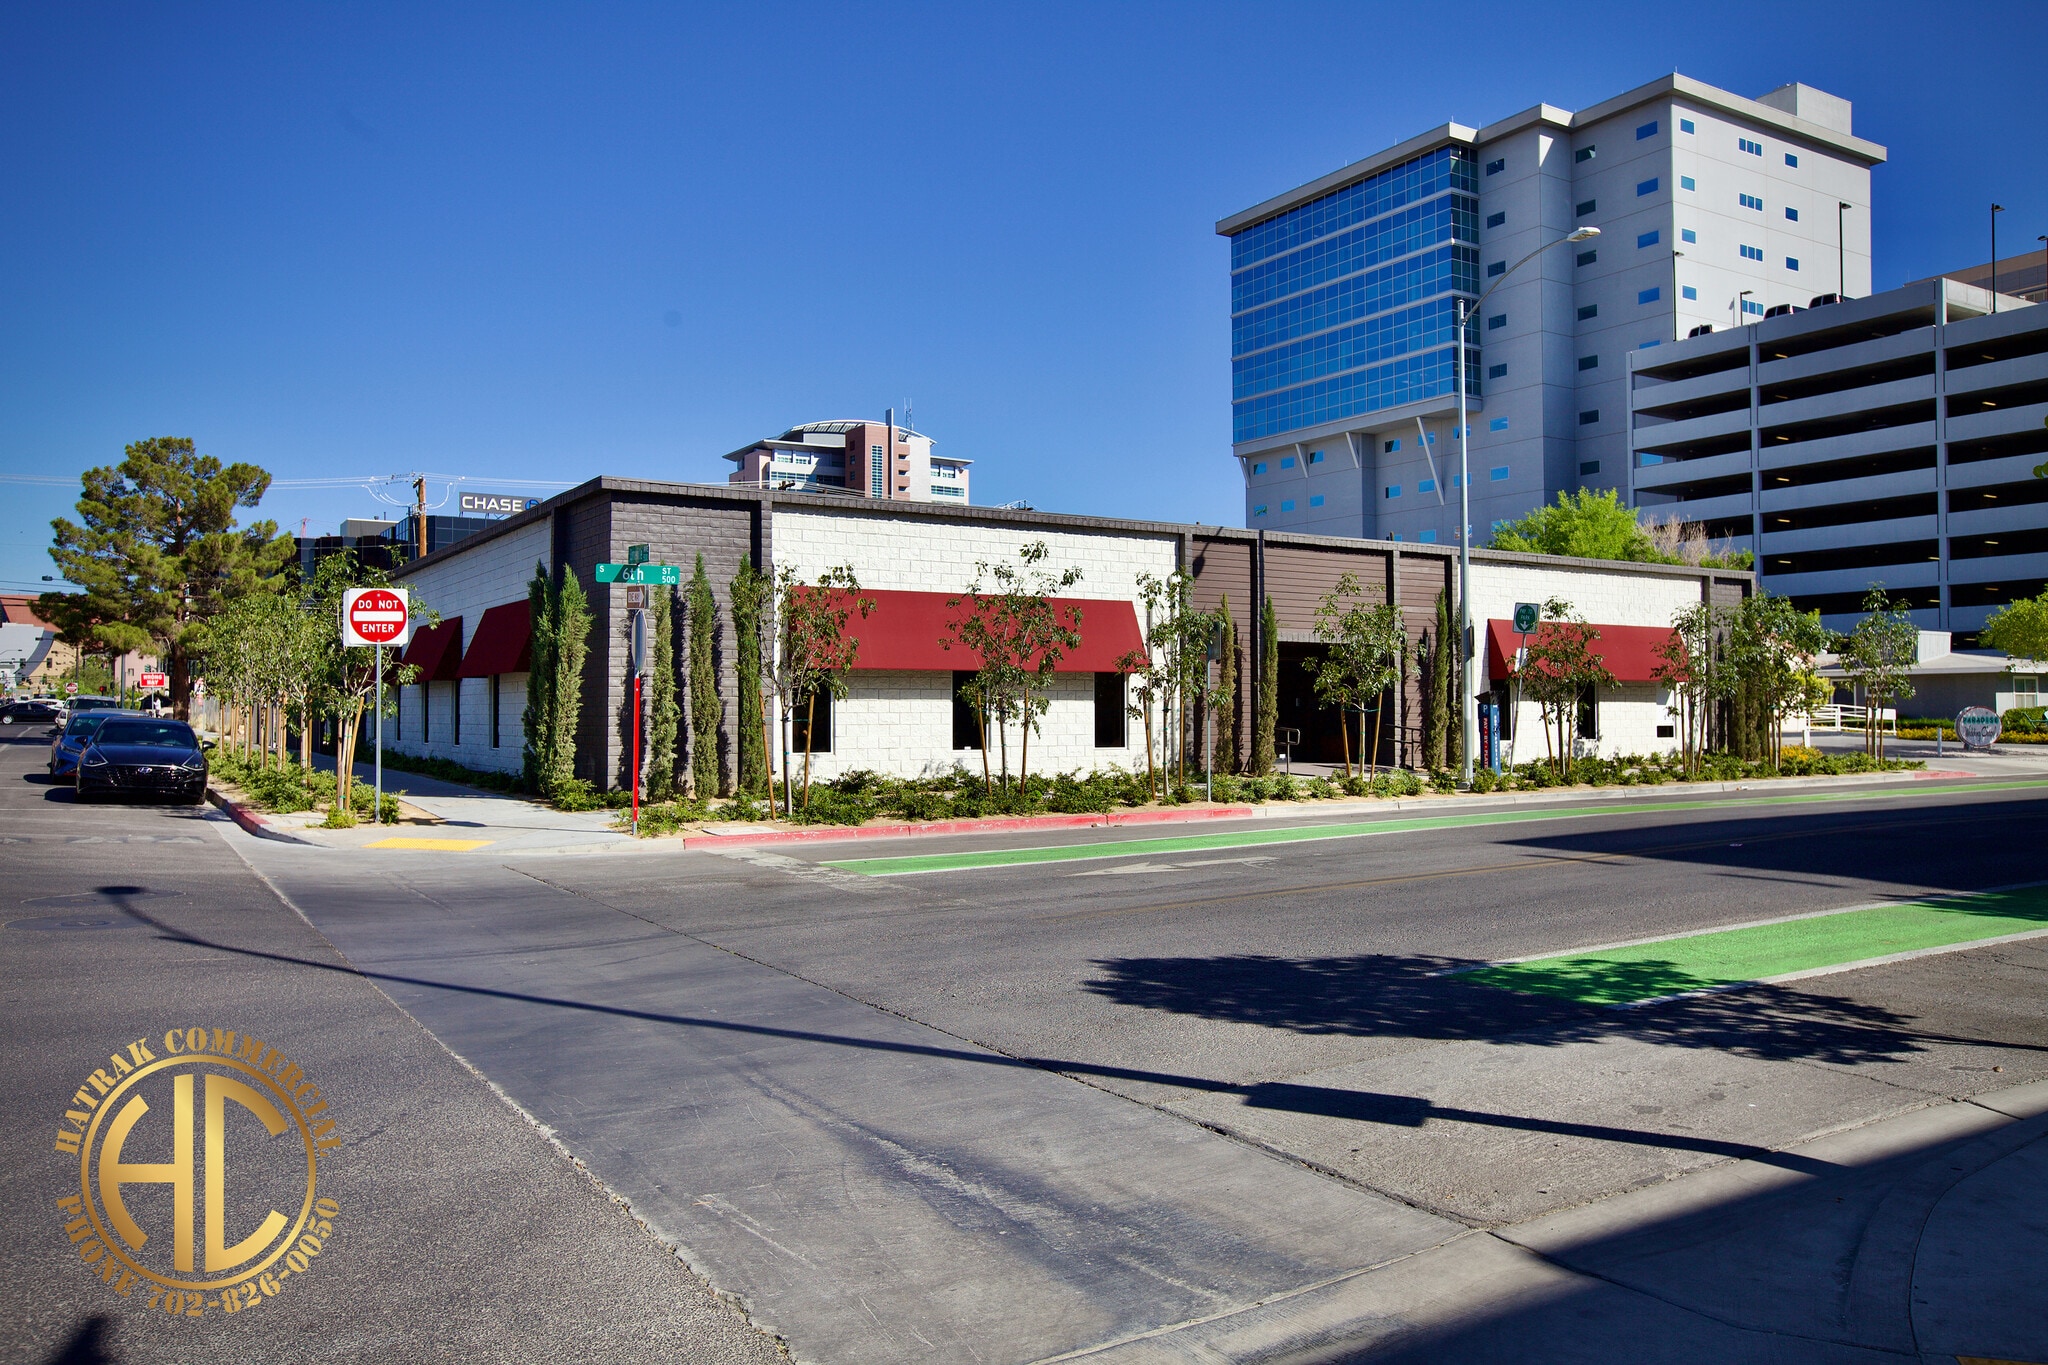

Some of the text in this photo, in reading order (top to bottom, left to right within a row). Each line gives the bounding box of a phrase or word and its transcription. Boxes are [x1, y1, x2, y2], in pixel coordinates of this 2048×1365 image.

[462, 496, 523, 512] CHASE
[599, 565, 671, 580] S 6th ST
[662, 576, 676, 584] 500
[358, 600, 399, 609] DO NOT
[362, 624, 395, 633] ENTER
[1963, 716, 1999, 724] PARADISE
